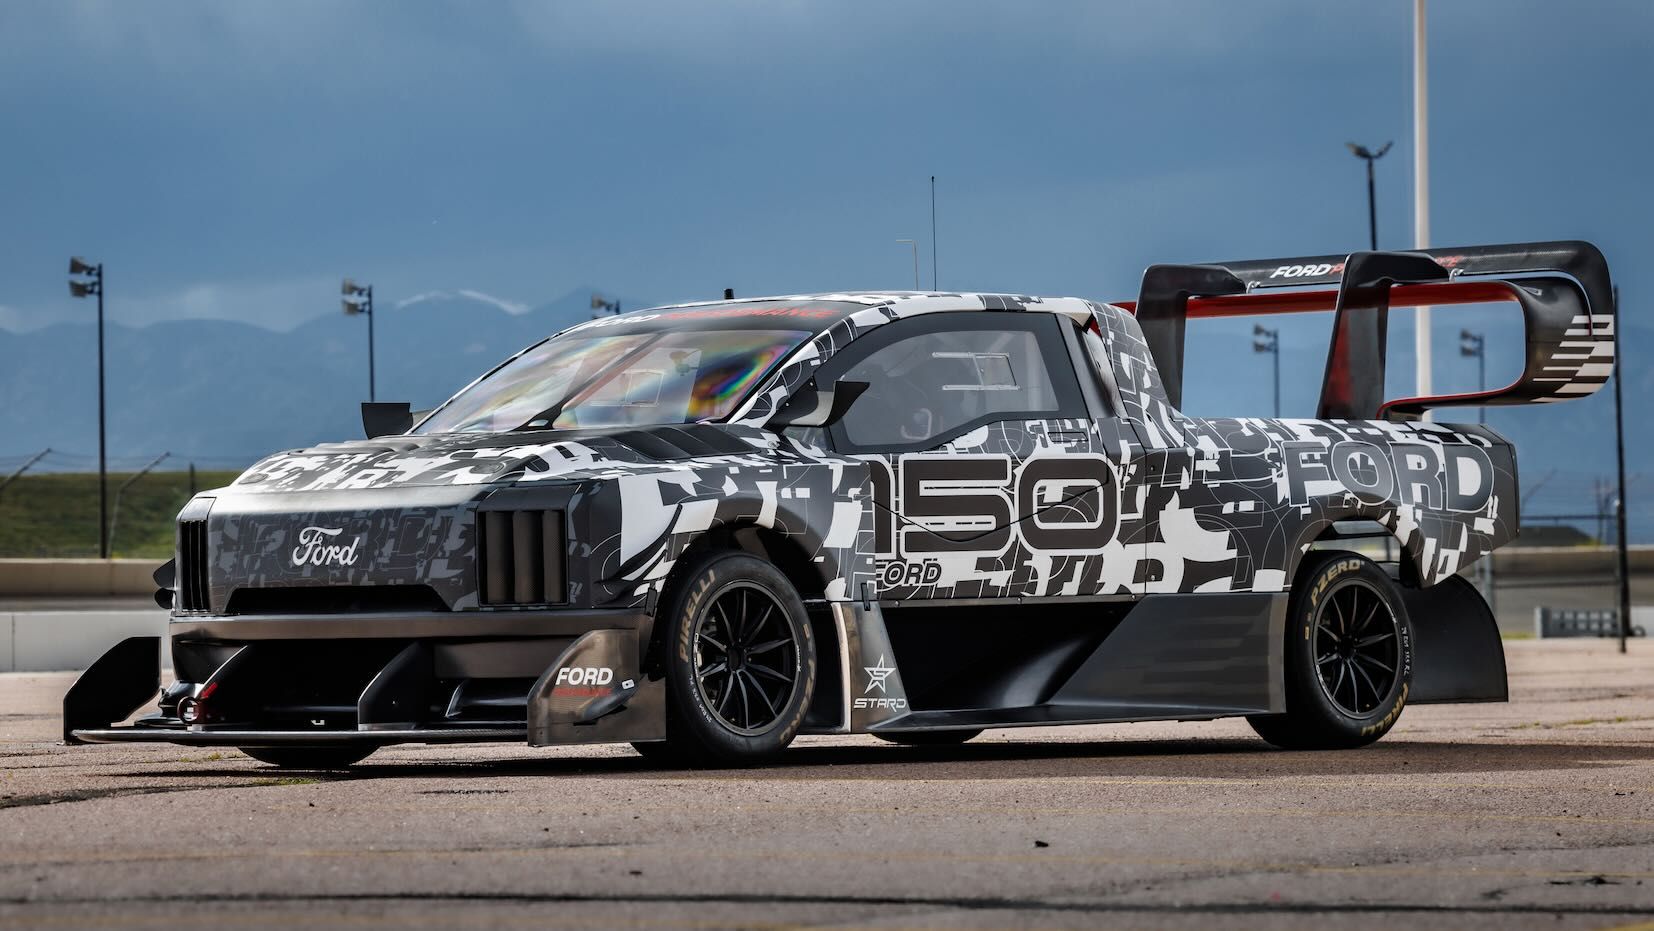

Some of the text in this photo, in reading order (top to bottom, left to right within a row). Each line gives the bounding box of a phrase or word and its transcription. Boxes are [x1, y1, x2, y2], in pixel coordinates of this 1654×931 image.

[1270, 263, 1331, 279] FORD
[1281, 441, 1495, 513] FORD
[868, 453, 1121, 560] 150
[292, 526, 360, 566] Ford
[679, 569, 716, 663] PIRELLI
[555, 667, 613, 685] FORD
[853, 698, 907, 713] STARD
